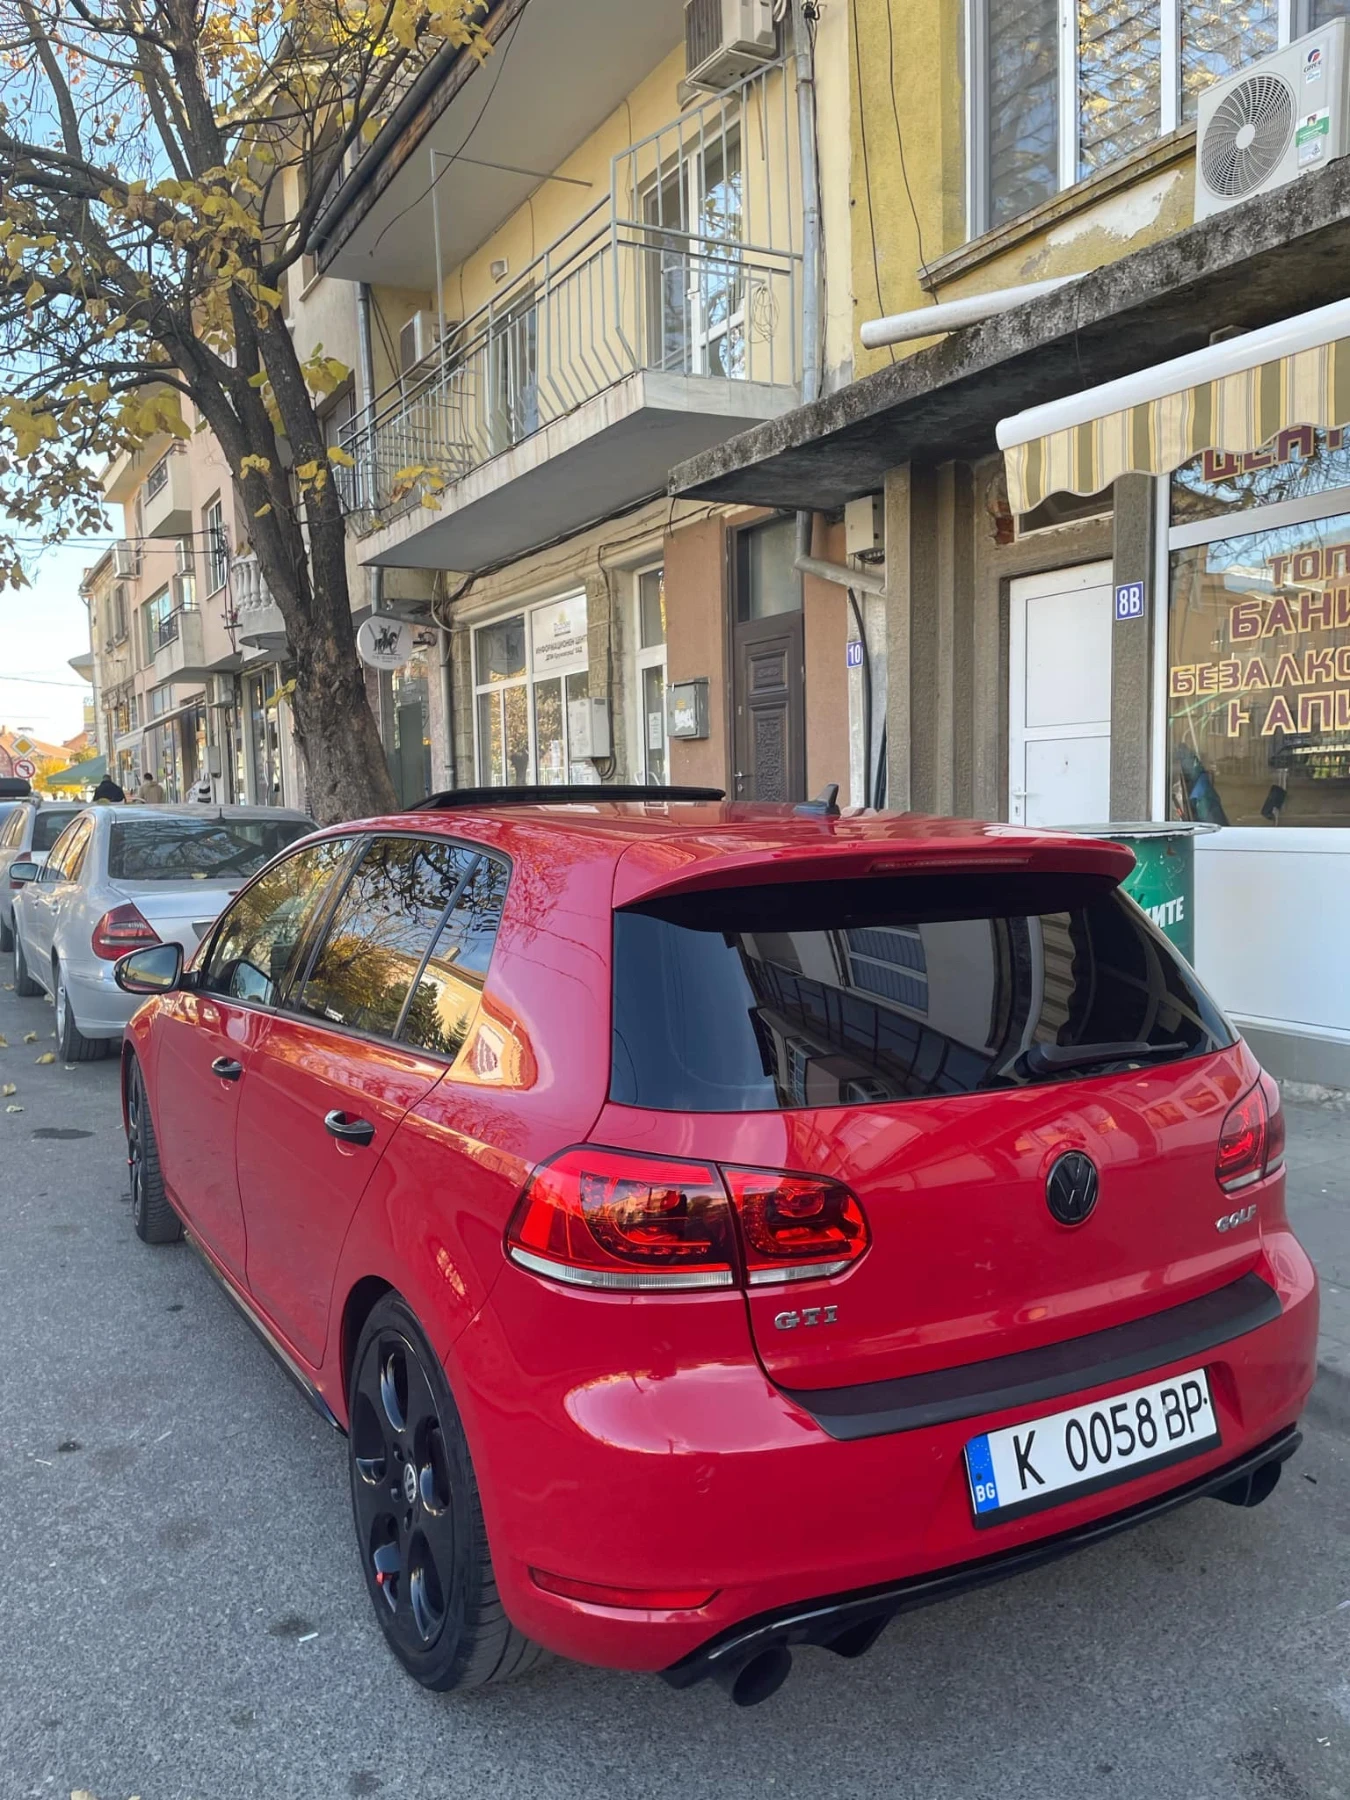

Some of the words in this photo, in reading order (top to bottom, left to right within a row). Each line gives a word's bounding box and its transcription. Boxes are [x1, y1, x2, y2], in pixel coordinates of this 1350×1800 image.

[849, 644, 861, 664] 10
[1216, 1203, 1257, 1233] GOLF
[774, 1304, 838, 1330] GTI
[975, 1482, 996, 1503] BG
